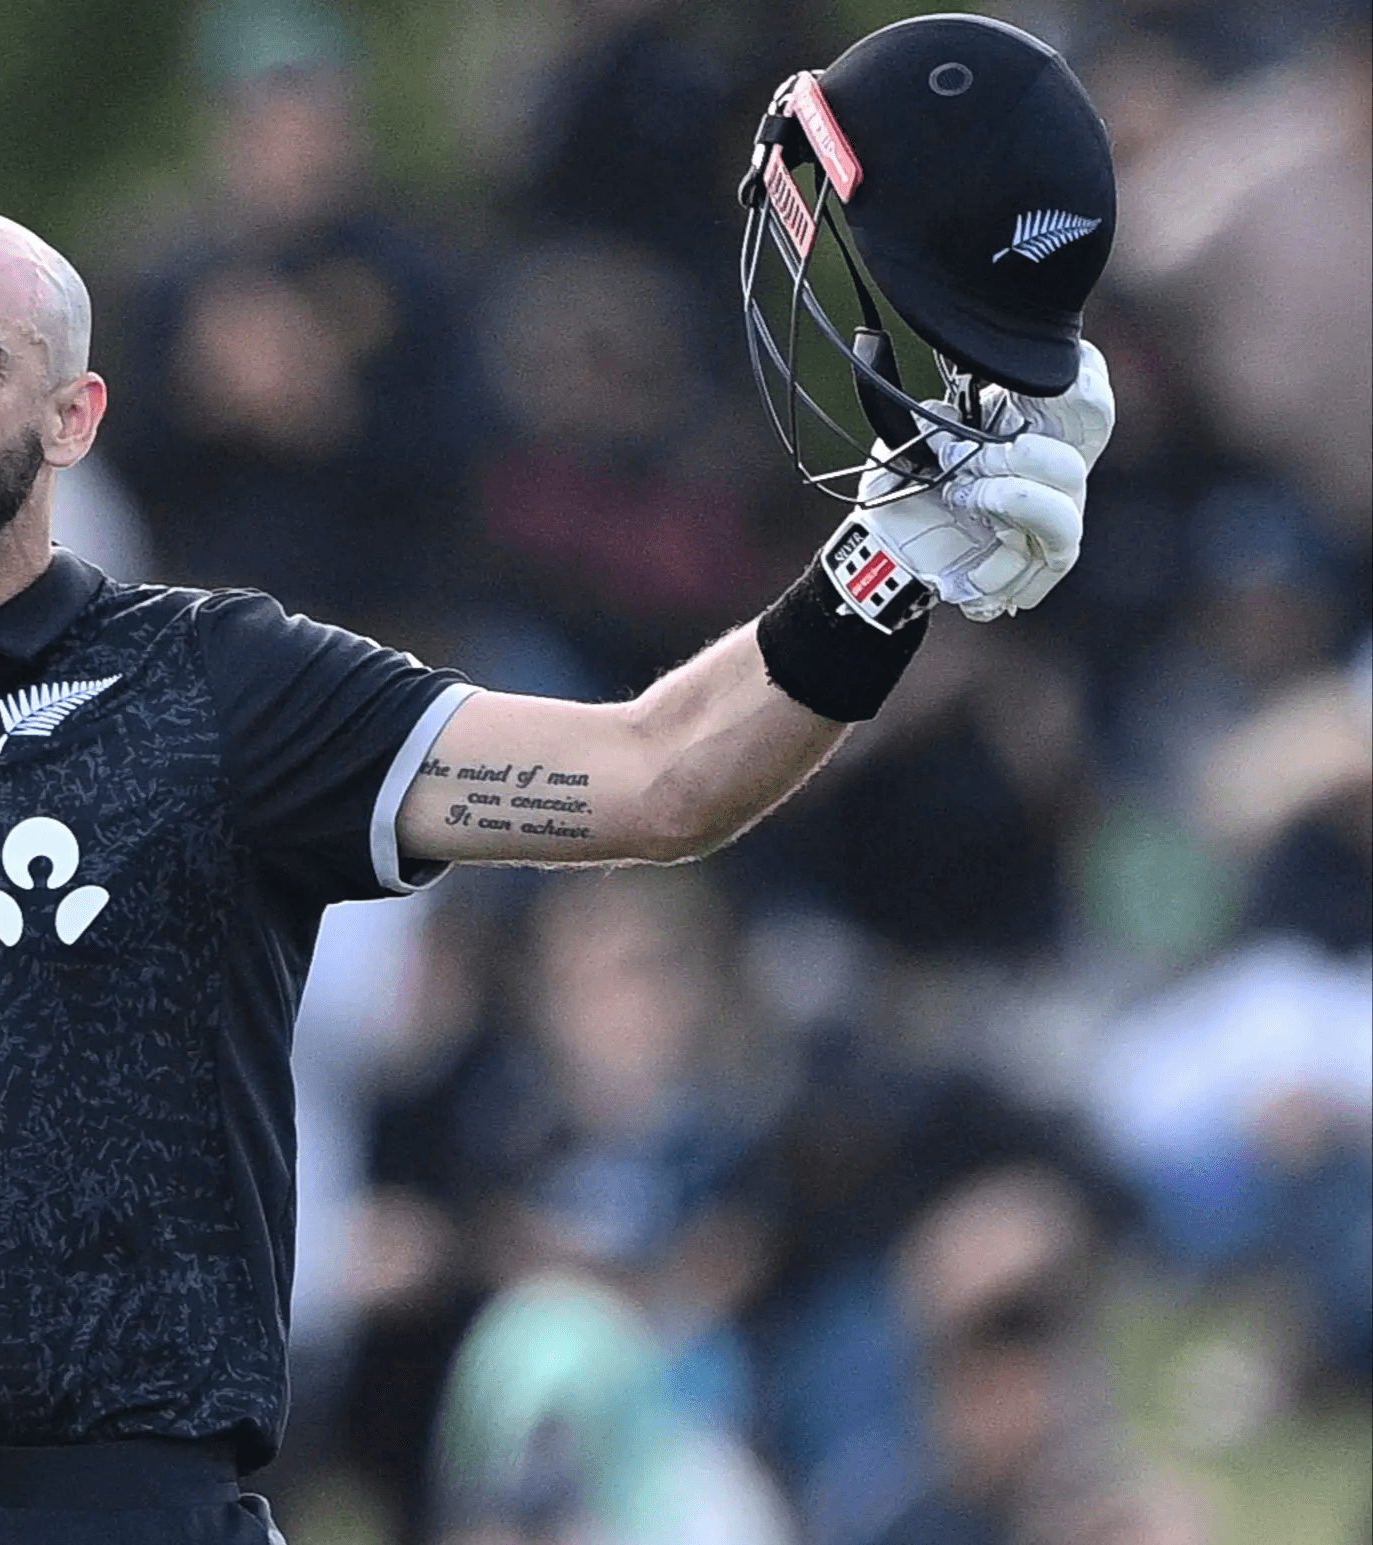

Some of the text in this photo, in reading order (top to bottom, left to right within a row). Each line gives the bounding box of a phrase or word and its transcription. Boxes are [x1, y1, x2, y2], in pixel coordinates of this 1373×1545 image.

[457, 764, 513, 782] mind
[516, 765, 543, 789] of
[547, 771, 590, 787] man
[467, 792, 501, 806] can
[445, 804, 472, 826] It
[478, 817, 511, 831] can
